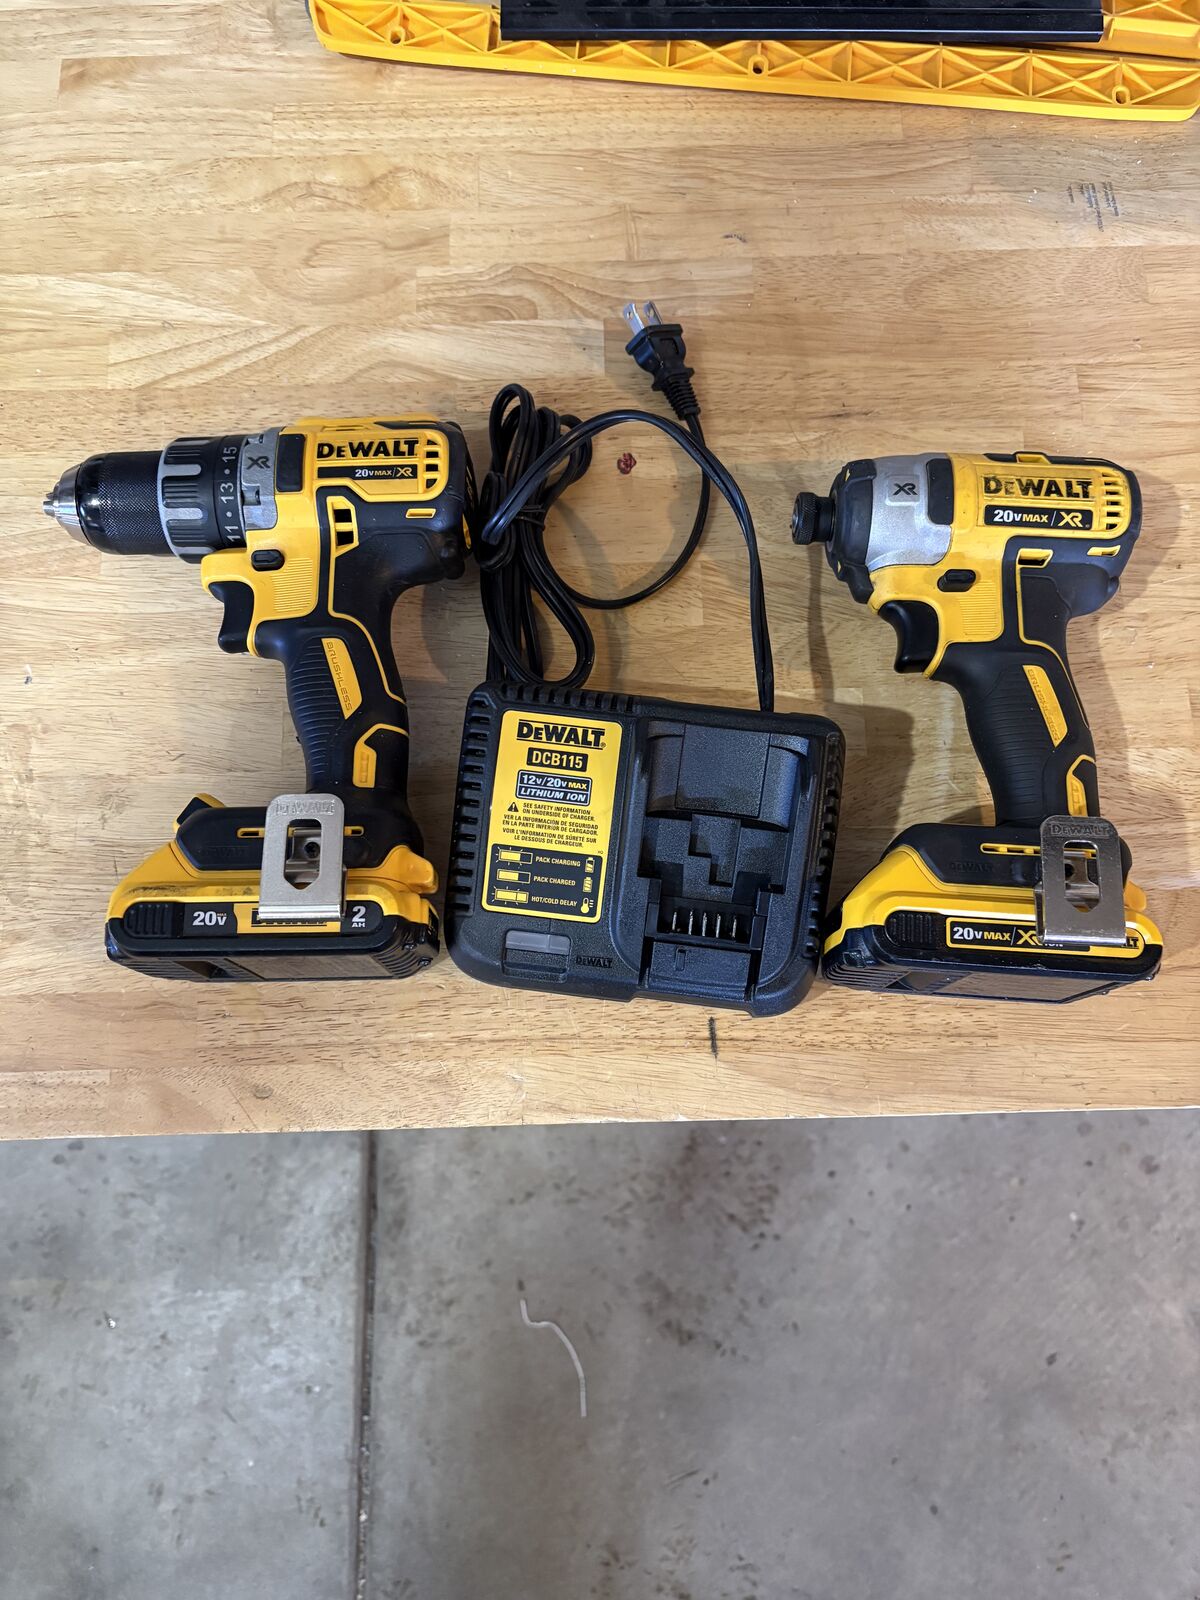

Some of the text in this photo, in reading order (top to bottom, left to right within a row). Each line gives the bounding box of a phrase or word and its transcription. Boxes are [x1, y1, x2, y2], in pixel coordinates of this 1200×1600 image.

[223, 446, 237, 463] 15
[246, 455, 270, 470] XR
[396, 467, 414, 477] XR
[220, 482, 234, 504] 13
[892, 482, 918, 496] XR
[1022, 513, 1049, 523] MAX
[1057, 511, 1083, 528] XR
[225, 524, 241, 543] 11
[326, 641, 353, 711] BRUSHLESS
[532, 750, 583, 769] DCB115
[568, 781, 587, 790] MAX
[520, 787, 586, 802] LITHIUM ION
[531, 809, 561, 818] UNDERSIDE
[533, 803, 553, 811] SAFETY
[554, 806, 590, 815] INFORMATION
[518, 821, 535, 829] PARTE
[535, 823, 560, 831] INFERIOR
[568, 821, 599, 830] SEGURIDAD
[516, 829, 556, 839] L'INFORMATION
[521, 835, 546, 843] DESSOUS
[535, 856, 581, 867] PACK CHARGING
[549, 877, 576, 886] CHARGED
[531, 895, 578, 907] HOT/COLD DELAY
[351, 905, 366, 922] 2
[983, 932, 1011, 941] MAX
